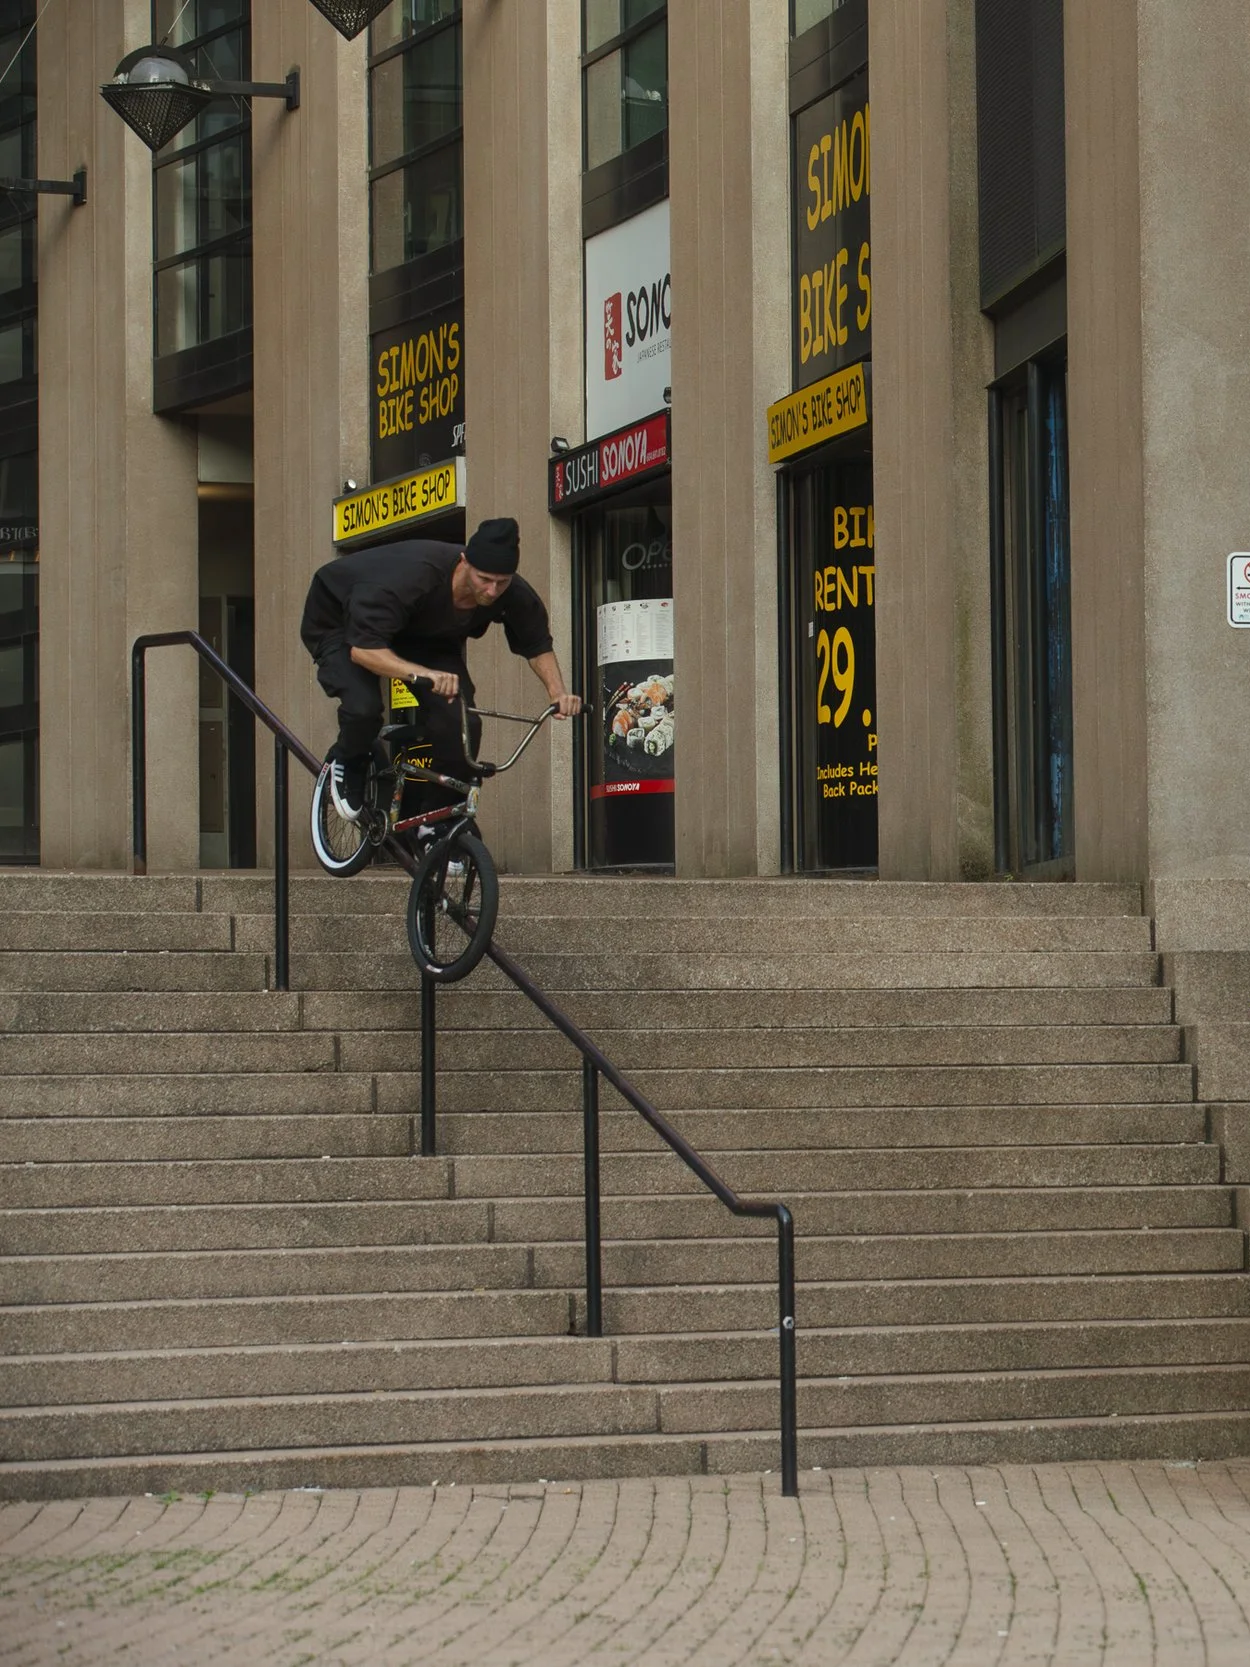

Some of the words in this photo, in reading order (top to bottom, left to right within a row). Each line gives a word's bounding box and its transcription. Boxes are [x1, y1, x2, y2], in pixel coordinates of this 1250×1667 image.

[800, 247, 849, 365] BIKE
[377, 322, 460, 397] SIMON'S
[379, 389, 415, 440] BIKE
[419, 372, 459, 425] SHOP
[770, 400, 809, 450] SIMON'S
[811, 386, 833, 431] BIKE
[835, 374, 861, 421] SHOP
[565, 450, 599, 496] SUSHI
[602, 428, 648, 481] SONOYA
[343, 492, 389, 532] SIMON'S
[392, 480, 417, 517] BIKE
[421, 469, 451, 507] SHOP
[815, 565, 875, 612] RENT
[617, 782, 640, 792] SONOYA
[816, 762, 854, 780] Includes
[860, 761, 878, 776] He
[823, 781, 846, 798] Back
